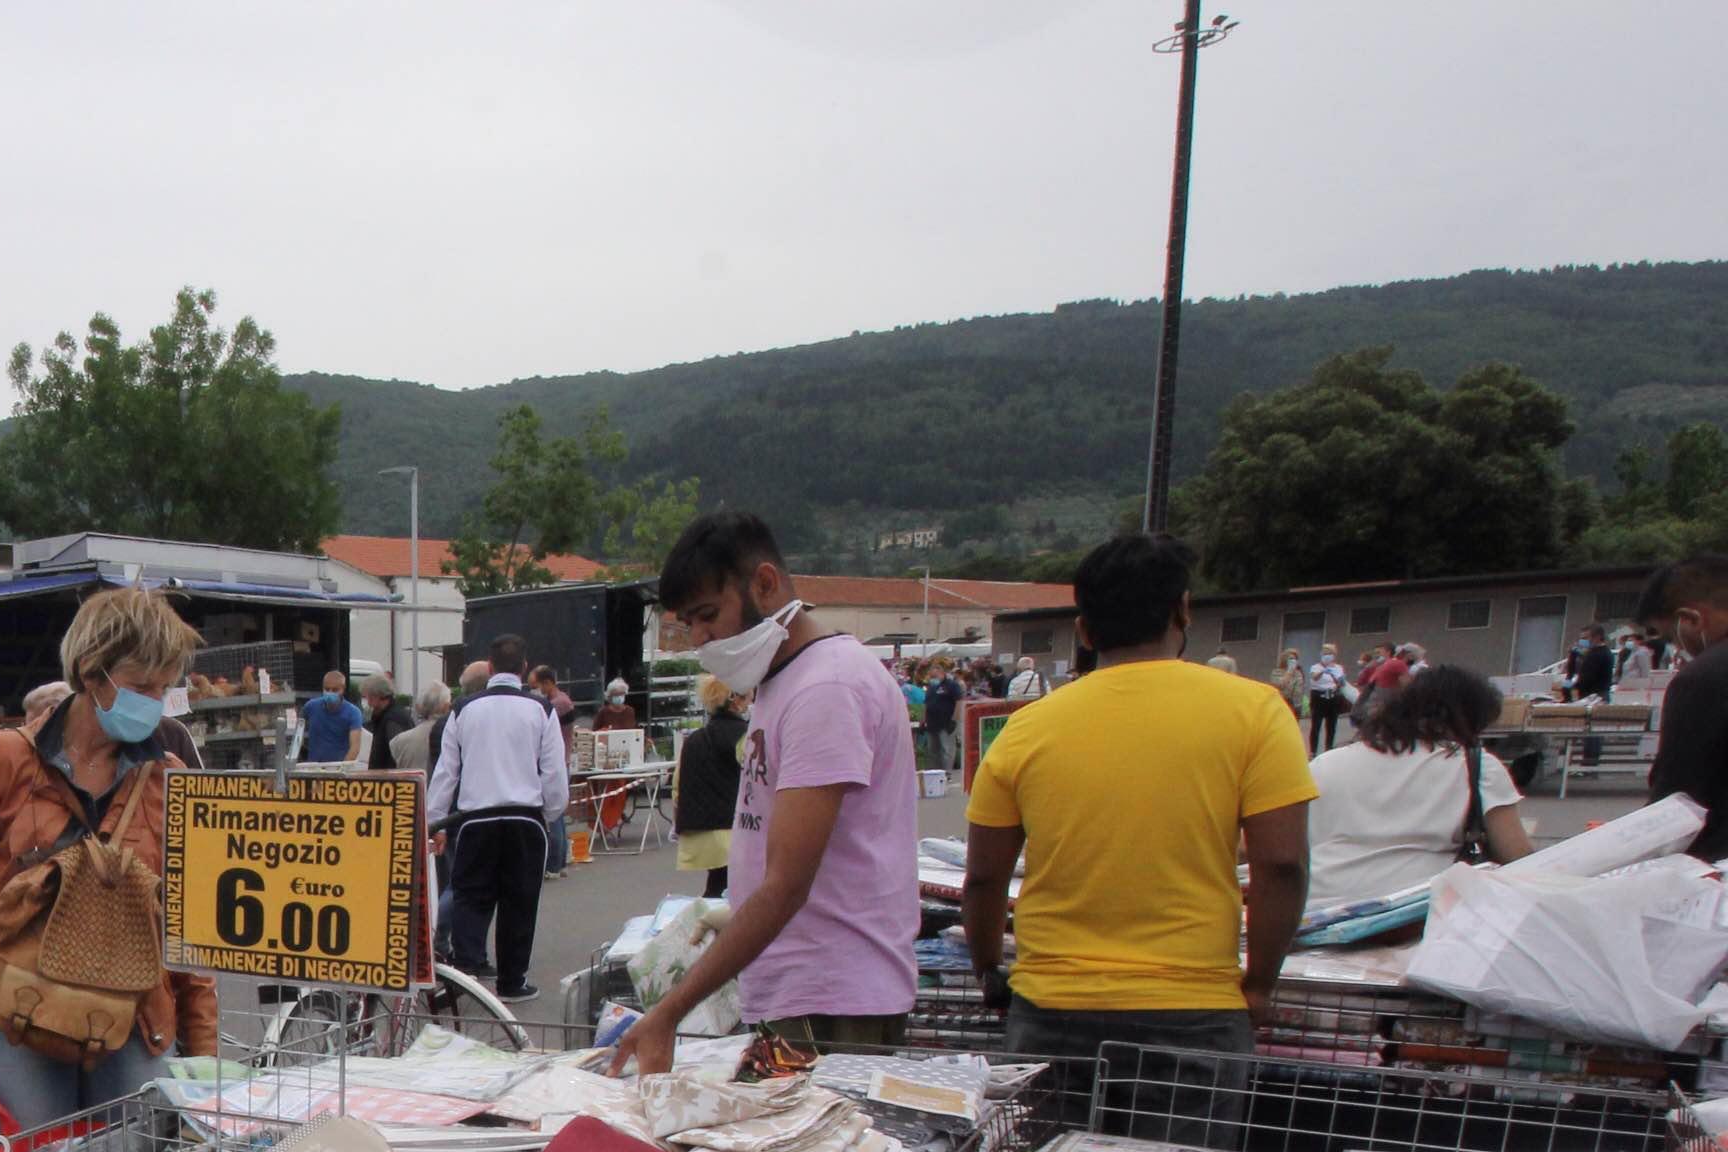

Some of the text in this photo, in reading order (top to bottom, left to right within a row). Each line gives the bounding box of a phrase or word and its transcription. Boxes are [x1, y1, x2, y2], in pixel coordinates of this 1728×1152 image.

[289, 780, 306, 800] DI
[311, 780, 395, 803] NEGOZIO
[192, 802, 382, 837] Rimanenze di
[227, 833, 341, 868] Negozio
[166, 775, 185, 964] RIMANENZE DI NEGOZIO
[290, 876, 345, 898] €uro
[387, 781, 416, 989] RIMANENZE DI NEGOZIO
[216, 867, 351, 956] 6.00
[183, 947, 387, 987] RIMANENZE DI NEGOZIO
